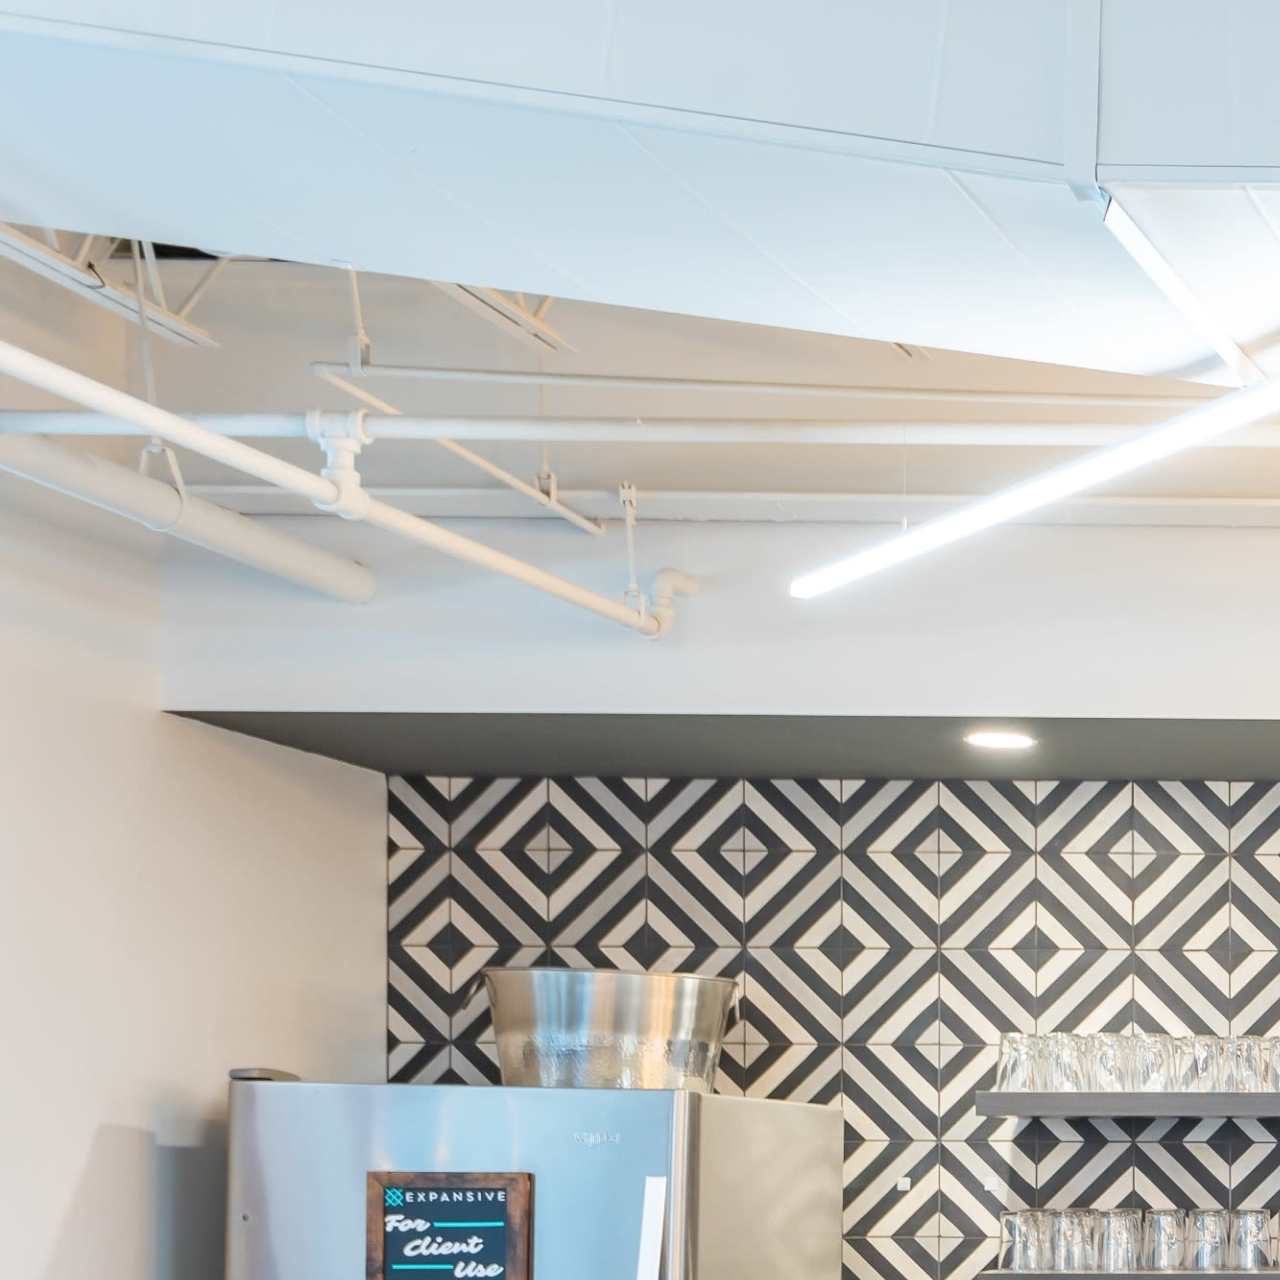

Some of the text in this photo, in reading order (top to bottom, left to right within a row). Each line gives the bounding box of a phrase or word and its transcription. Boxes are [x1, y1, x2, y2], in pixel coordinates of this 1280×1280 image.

[406, 1191, 507, 1202] EXPANSIVE
[384, 1214, 431, 1232] For
[403, 1236, 484, 1257] Client
[454, 1261, 504, 1278] Use
